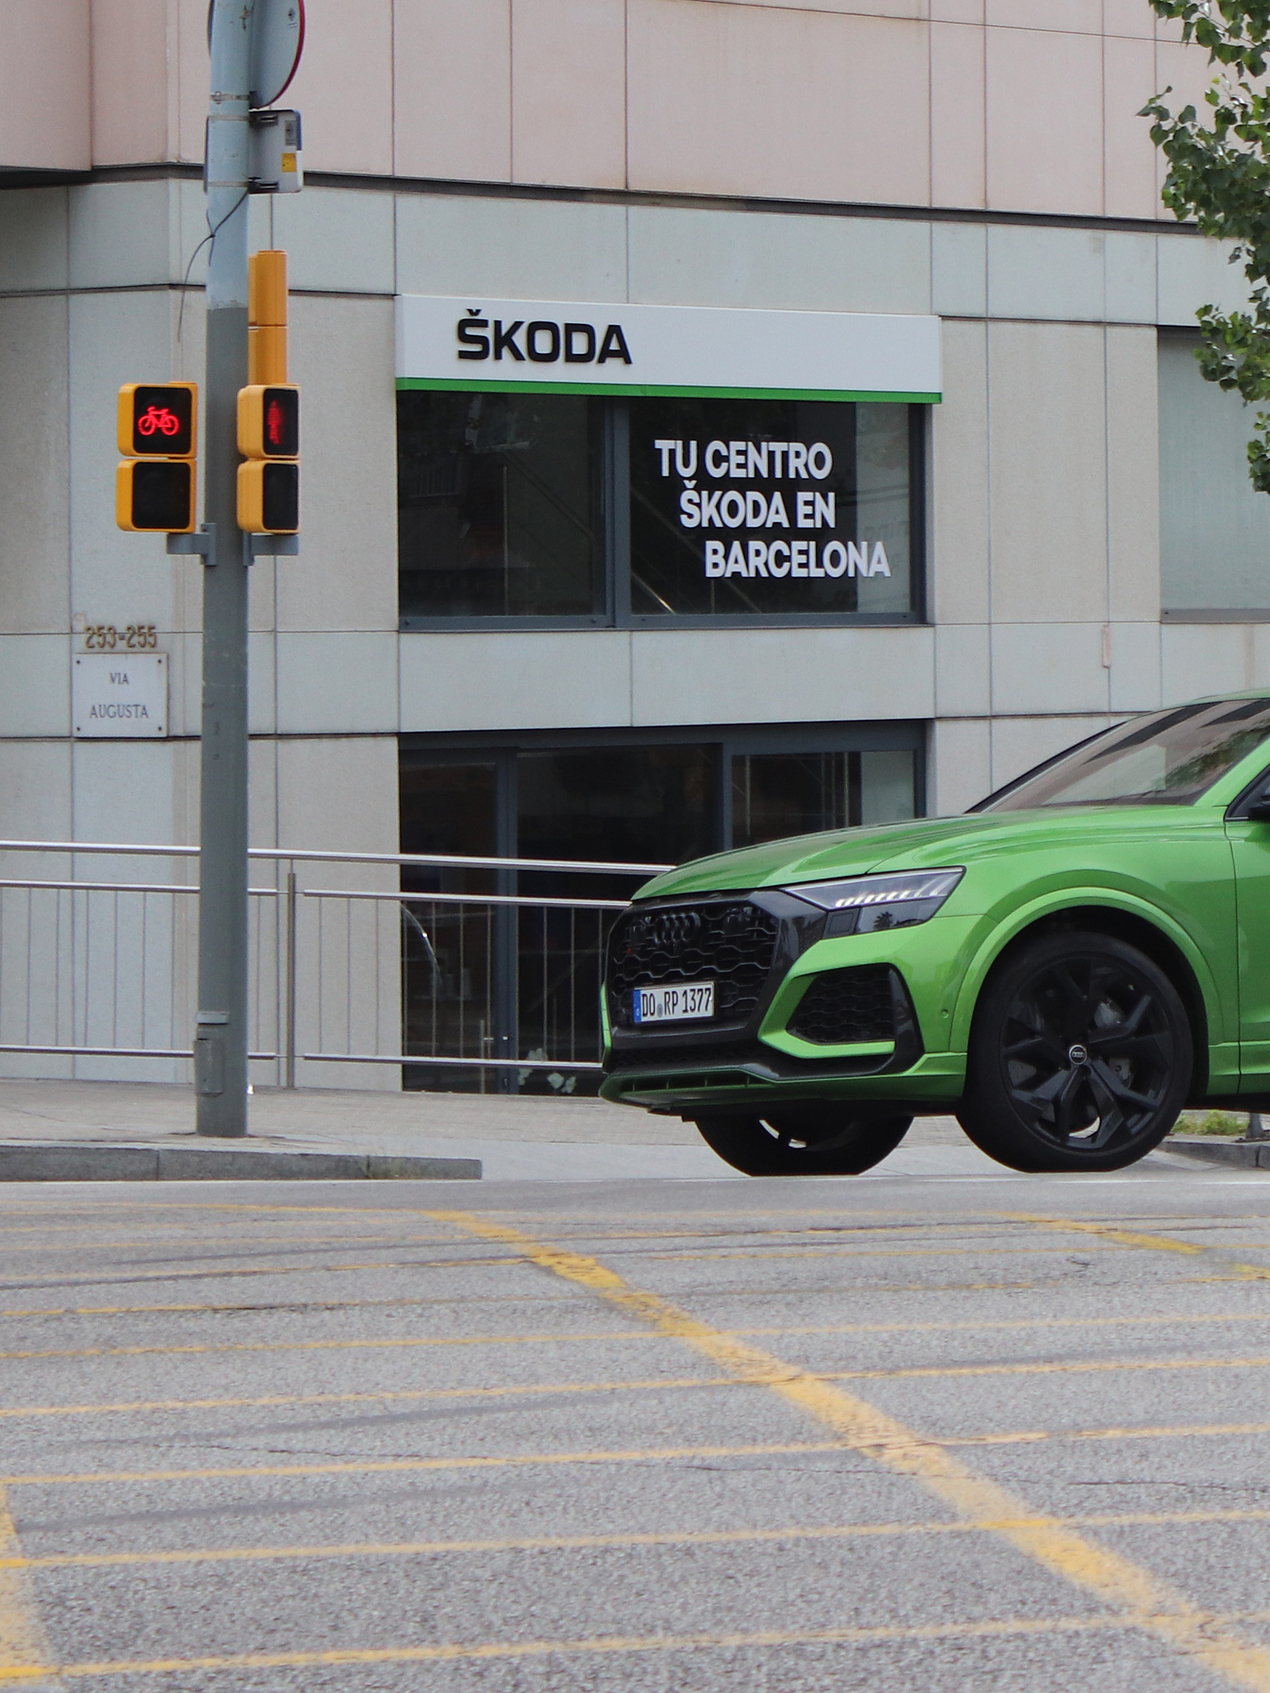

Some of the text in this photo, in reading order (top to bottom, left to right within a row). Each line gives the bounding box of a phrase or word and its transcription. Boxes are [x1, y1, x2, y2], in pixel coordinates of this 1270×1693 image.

[456, 309, 632, 364] ŠKODA
[654, 440, 833, 480] TU CENTRO
[680, 480, 836, 528] ŠKODA EN
[705, 540, 891, 578] BARCELONA
[85, 625, 158, 649] 253-255
[109, 672, 130, 685] VIA
[89, 704, 149, 719] AUGUSTA
[682, 987, 712, 1013] 1377
